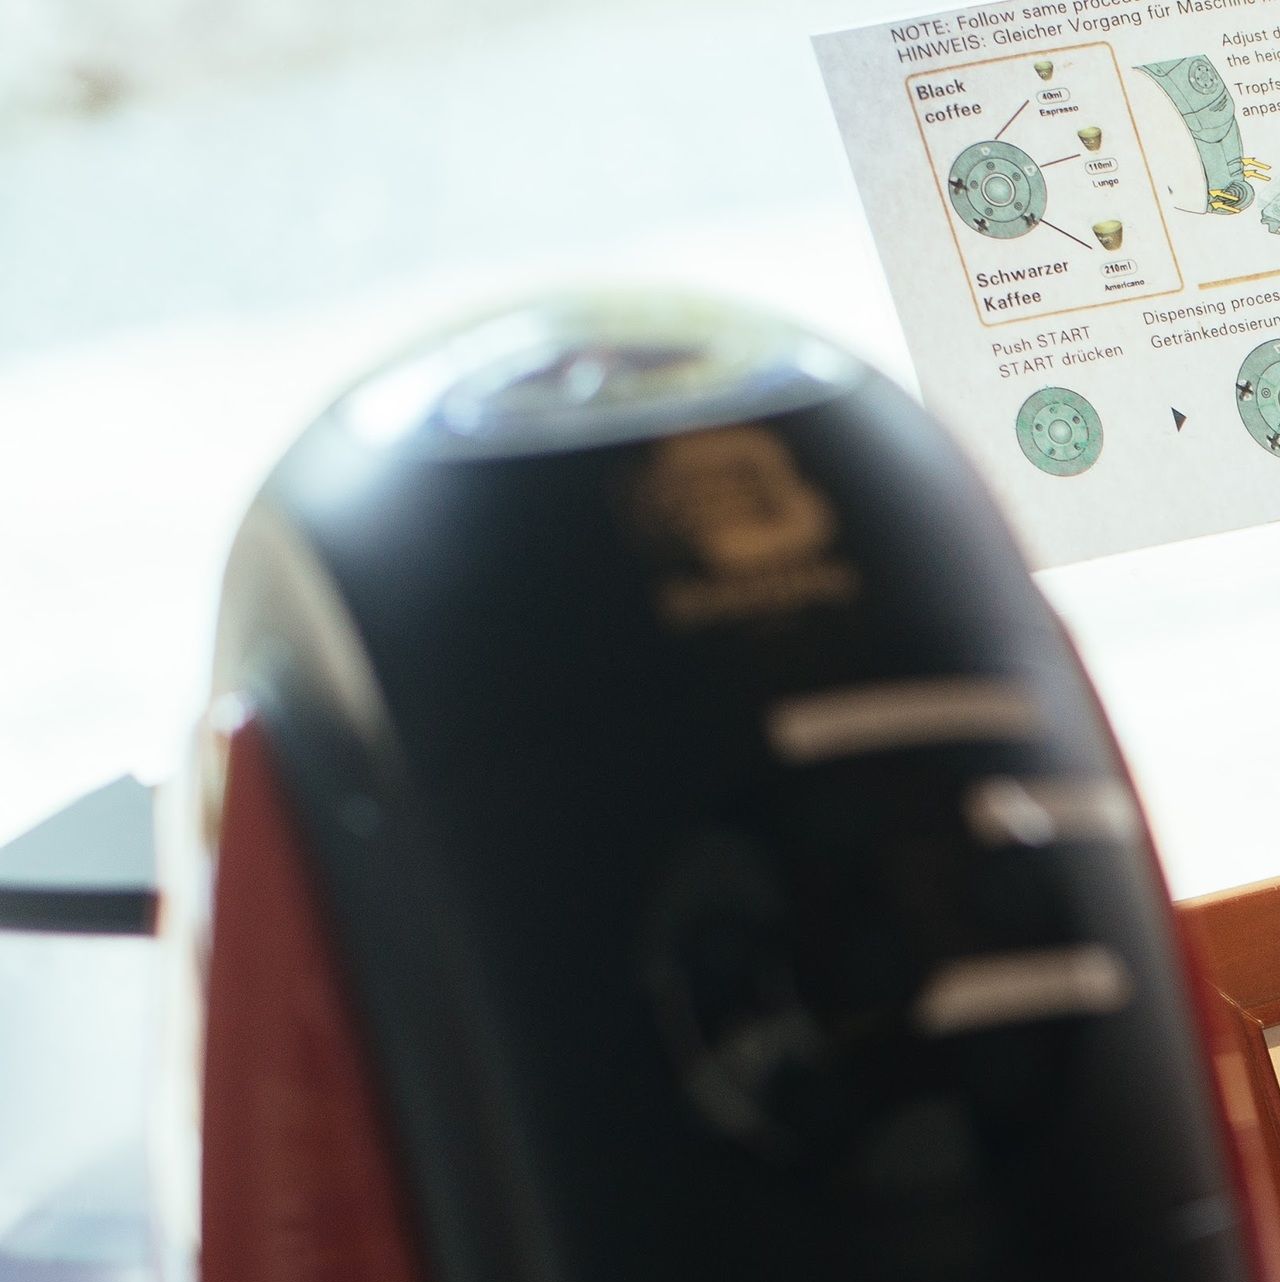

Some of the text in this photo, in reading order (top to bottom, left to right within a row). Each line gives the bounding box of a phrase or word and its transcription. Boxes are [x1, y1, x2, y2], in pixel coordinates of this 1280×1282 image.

[890, 19, 951, 43] NOTE:
[956, 11, 1015, 31] Follow
[1022, 3, 1067, 20] same
[896, 34, 987, 63] HINWEIS:
[992, 23, 1063, 45] Gleicher
[1068, 11, 1142, 35] Vorgang
[1147, 4, 1170, 19] für
[1222, 31, 1269, 47] Adjust
[1226, 54, 1251, 67] the
[916, 79, 967, 101] Black
[924, 102, 982, 124] coffee
[1039, 104, 1079, 117] Espresso
[1092, 177, 1119, 188] Lungo
[976, 260, 1069, 288] Schwarzer
[1104, 278, 1146, 292] Americano
[984, 291, 1042, 312] Kaffee
[1143, 300, 1226, 326] Dispensing
[992, 325, 1091, 357] Push START
[998, 343, 1124, 378] START drücken
